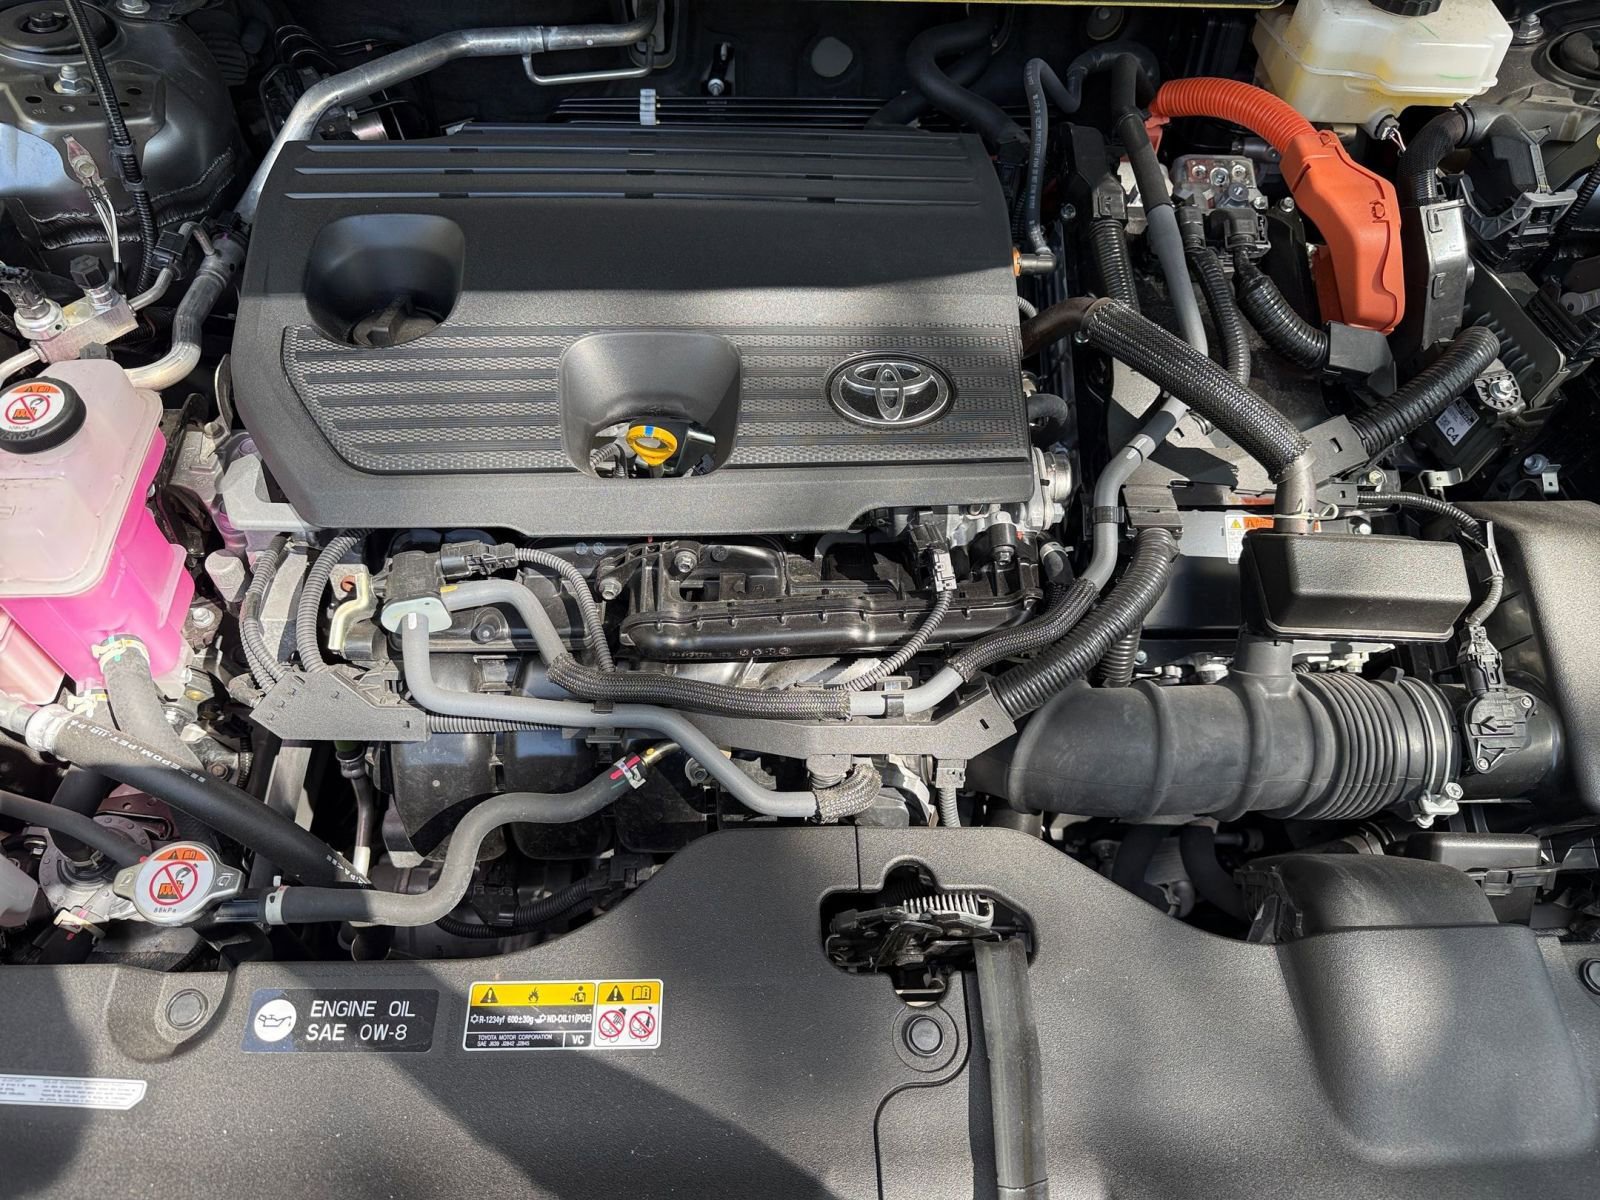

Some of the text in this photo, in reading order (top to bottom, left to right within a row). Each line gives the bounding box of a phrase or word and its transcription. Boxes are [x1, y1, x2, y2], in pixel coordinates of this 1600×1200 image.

[1446, 426, 1459, 441] C4
[310, 1000, 416, 1017] ENGINE OIL
[479, 1015, 506, 1026] R-1234yf
[305, 1023, 408, 1041] SAE 0W-8
[571, 1034, 585, 1045] VC
